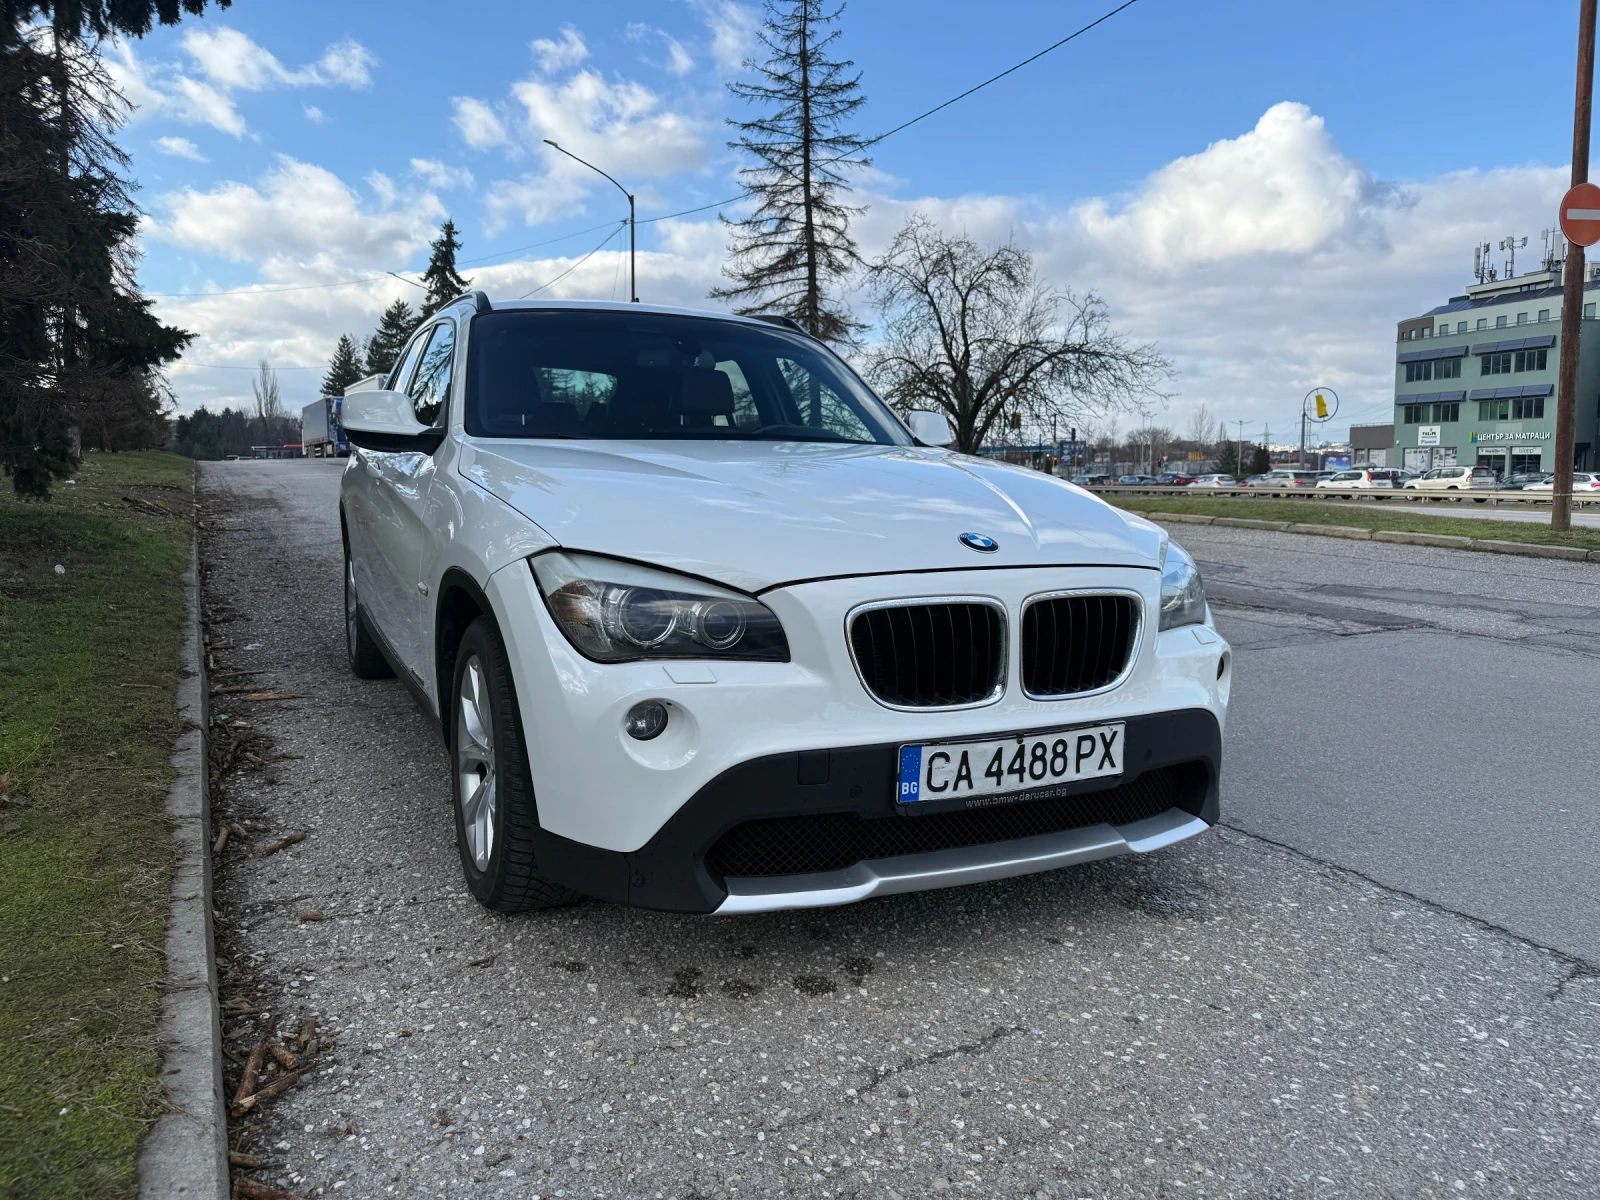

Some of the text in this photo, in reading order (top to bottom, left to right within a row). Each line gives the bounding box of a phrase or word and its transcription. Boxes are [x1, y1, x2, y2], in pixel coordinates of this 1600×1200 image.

[1477, 431, 1551, 441] ЦЕНТЪР ЗА МАТРАЦИ
[926, 730, 1119, 793] CA 4488 PX
[901, 781, 918, 795] BG
[965, 787, 1068, 808] www.bmw-darucar.bg
